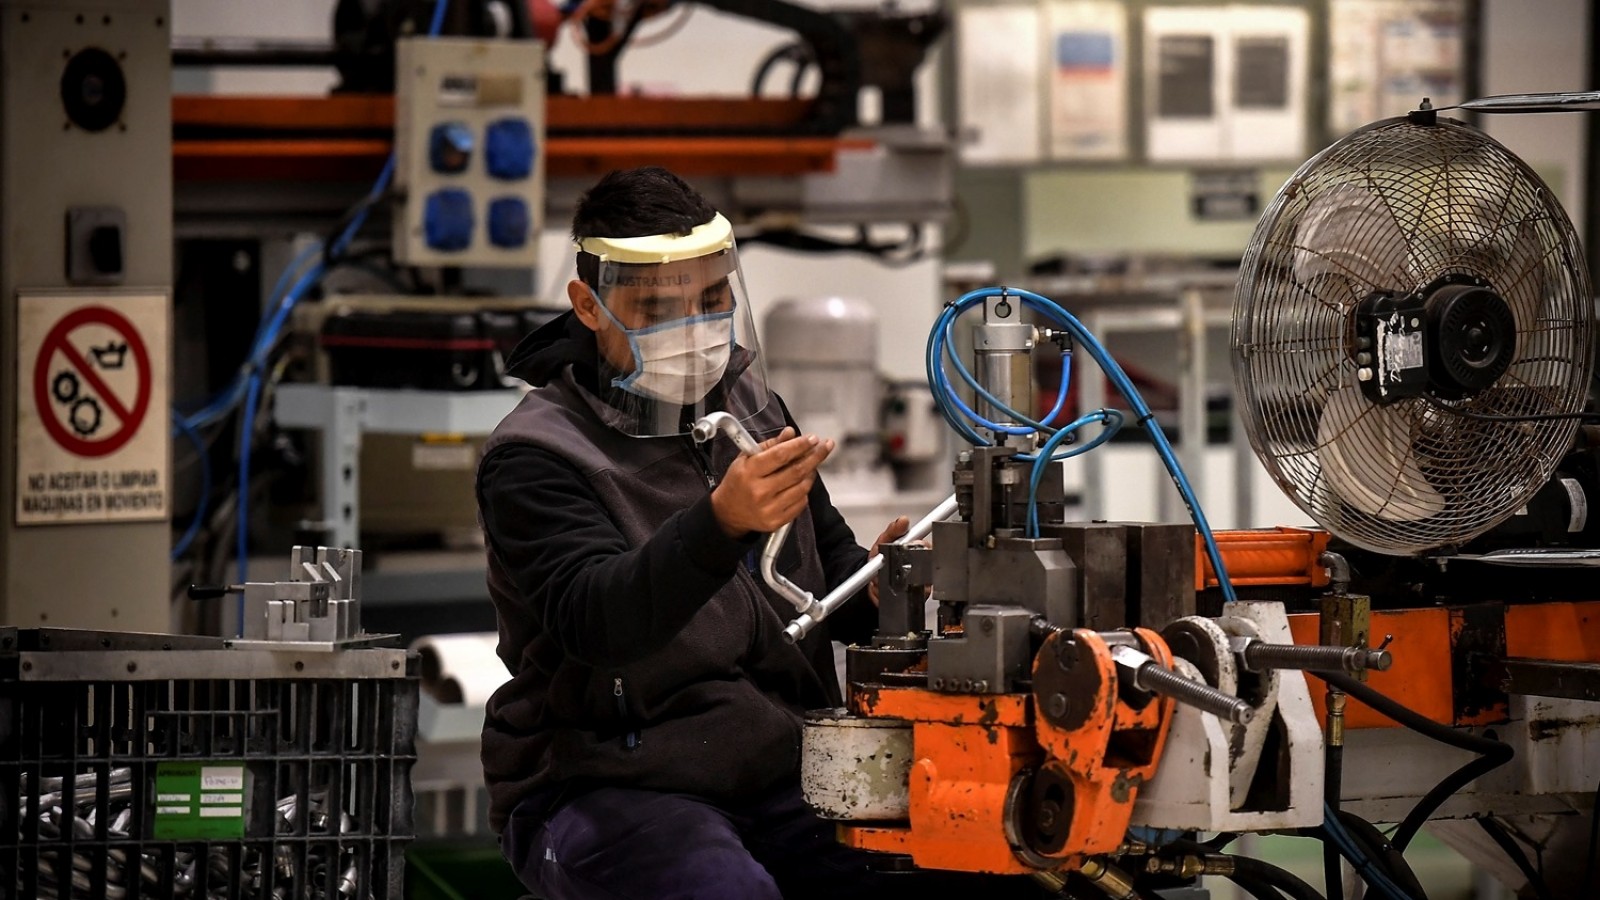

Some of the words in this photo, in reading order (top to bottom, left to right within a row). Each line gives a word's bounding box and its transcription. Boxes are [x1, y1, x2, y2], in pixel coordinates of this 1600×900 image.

[28, 473, 45, 491] NO
[49, 471, 98, 491] ACEITAR
[100, 470, 109, 490] O
[22, 494, 83, 513] MAQUINAS
[86, 492, 101, 511] EN
